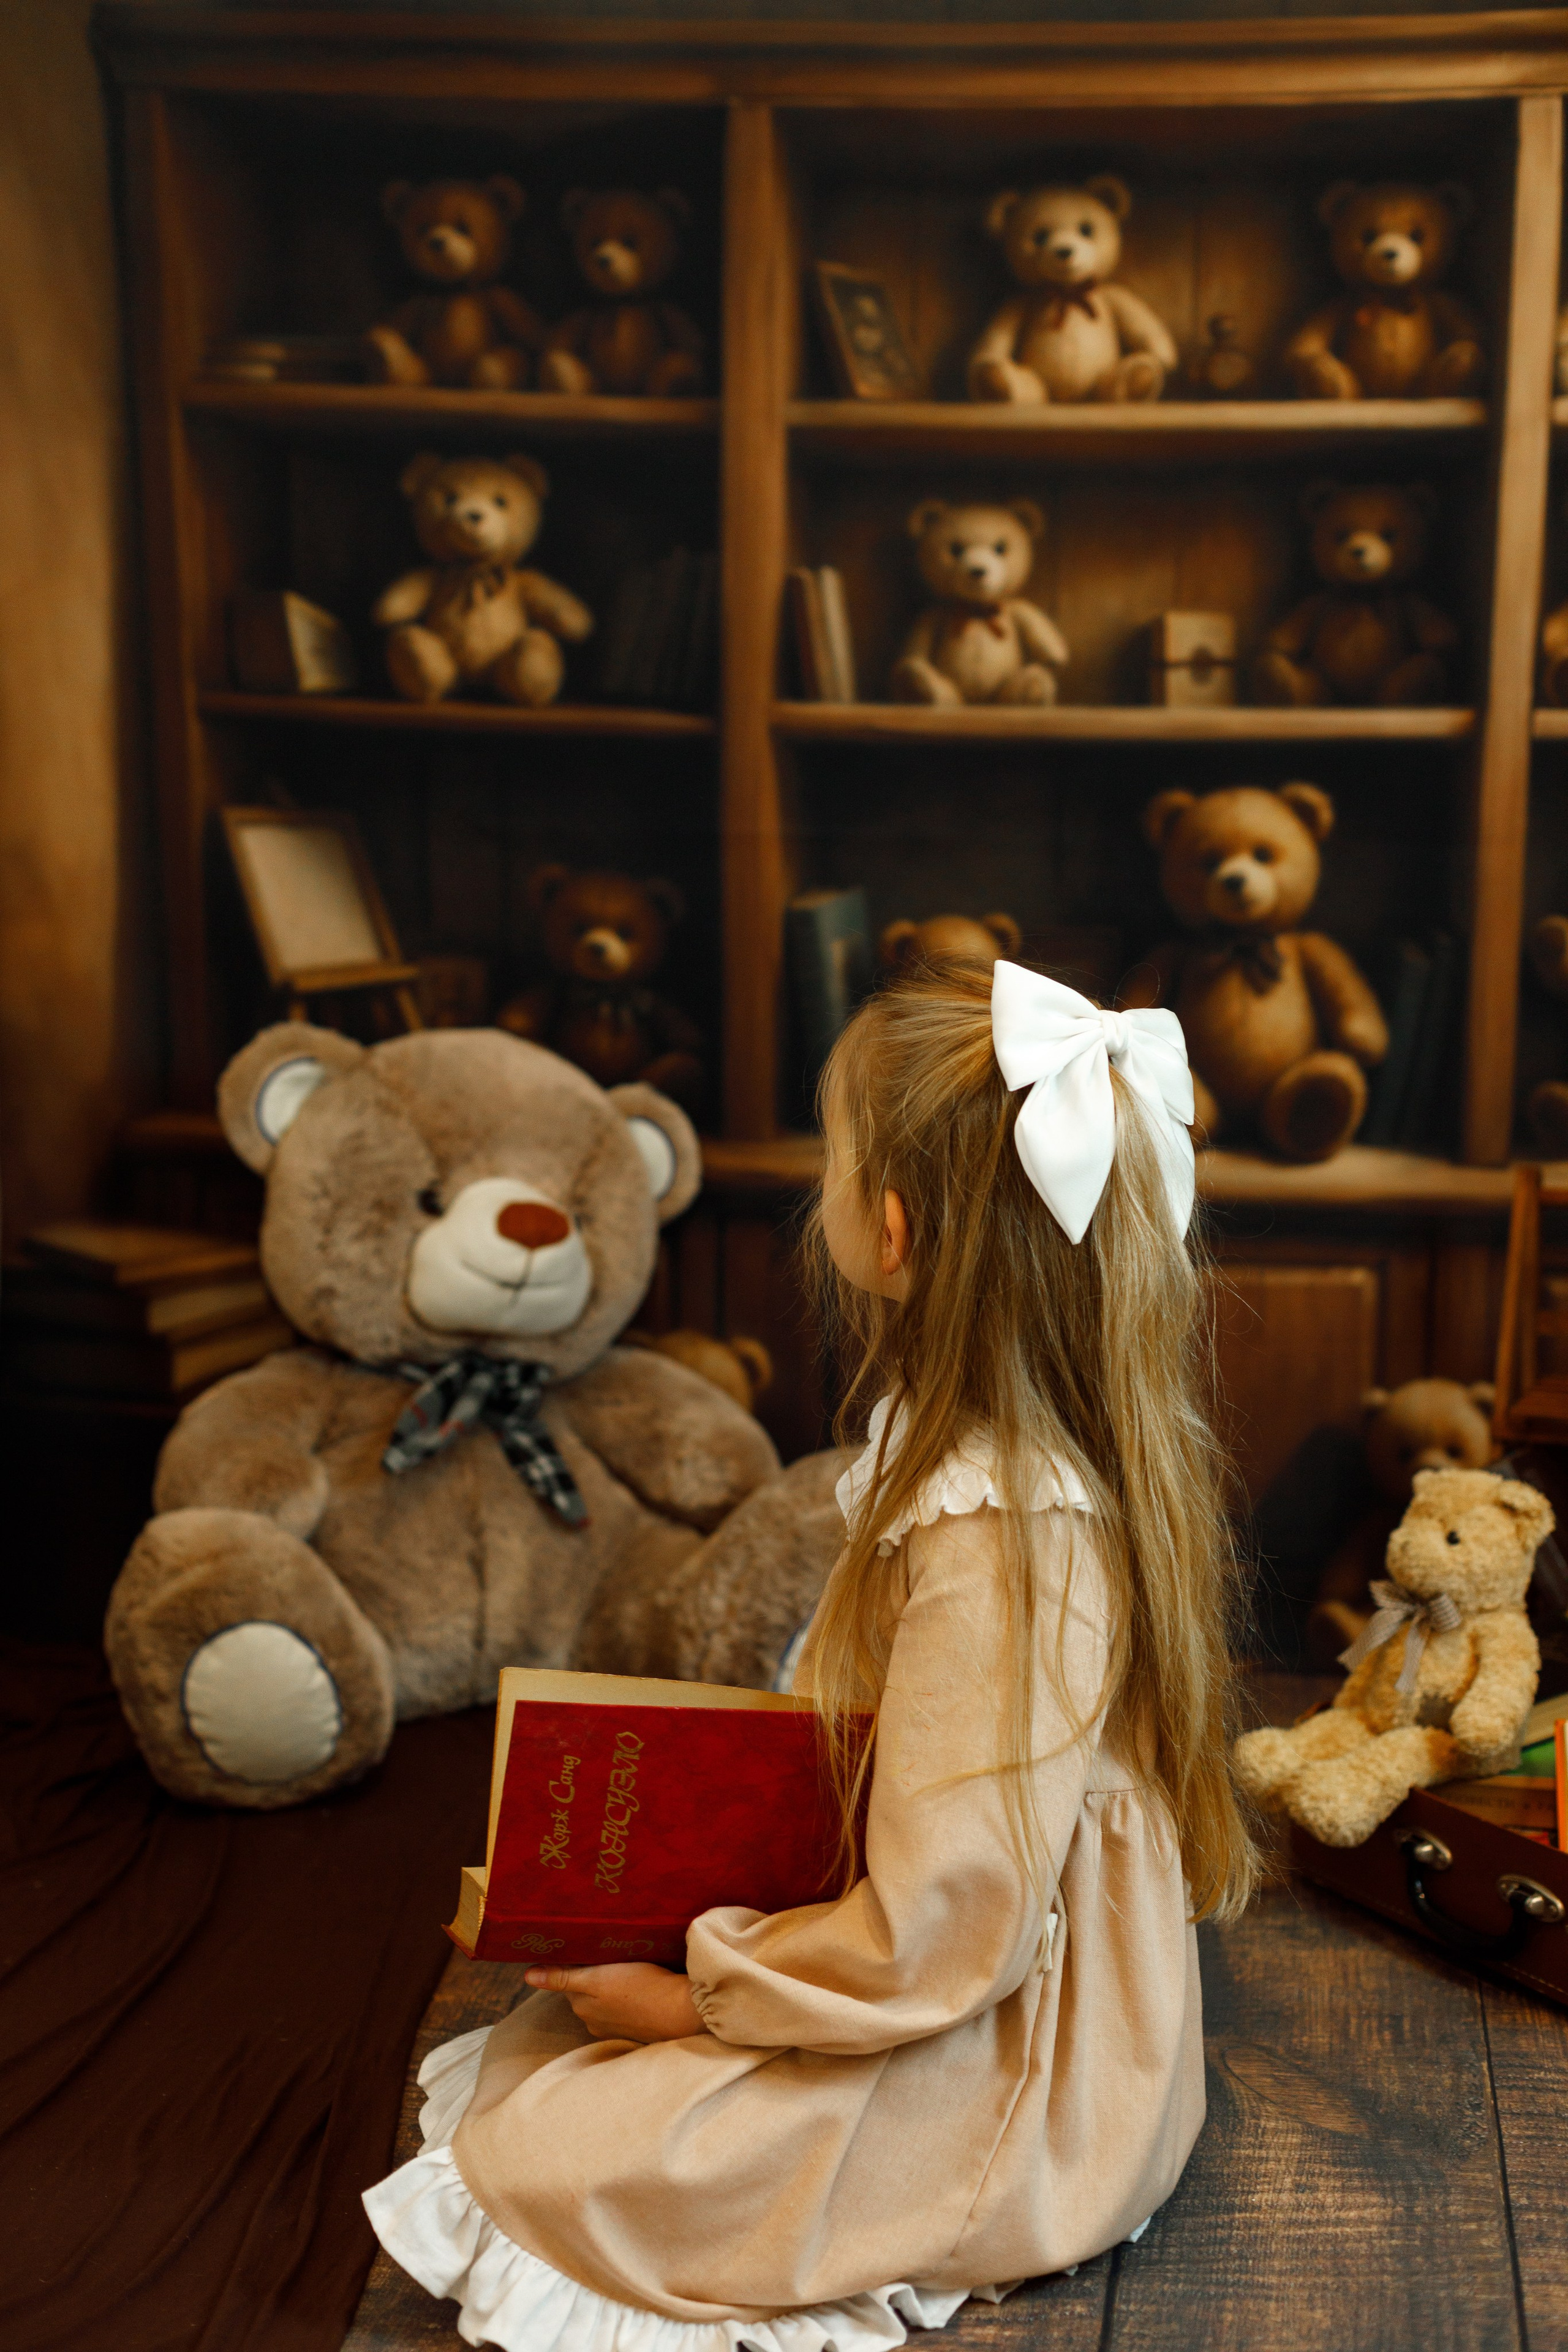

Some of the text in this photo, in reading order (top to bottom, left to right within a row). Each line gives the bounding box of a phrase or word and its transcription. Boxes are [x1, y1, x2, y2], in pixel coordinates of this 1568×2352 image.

[539, 1755, 581, 1869] Жорж Санд
[595, 1731, 646, 1893] КОНСУЭЛО
